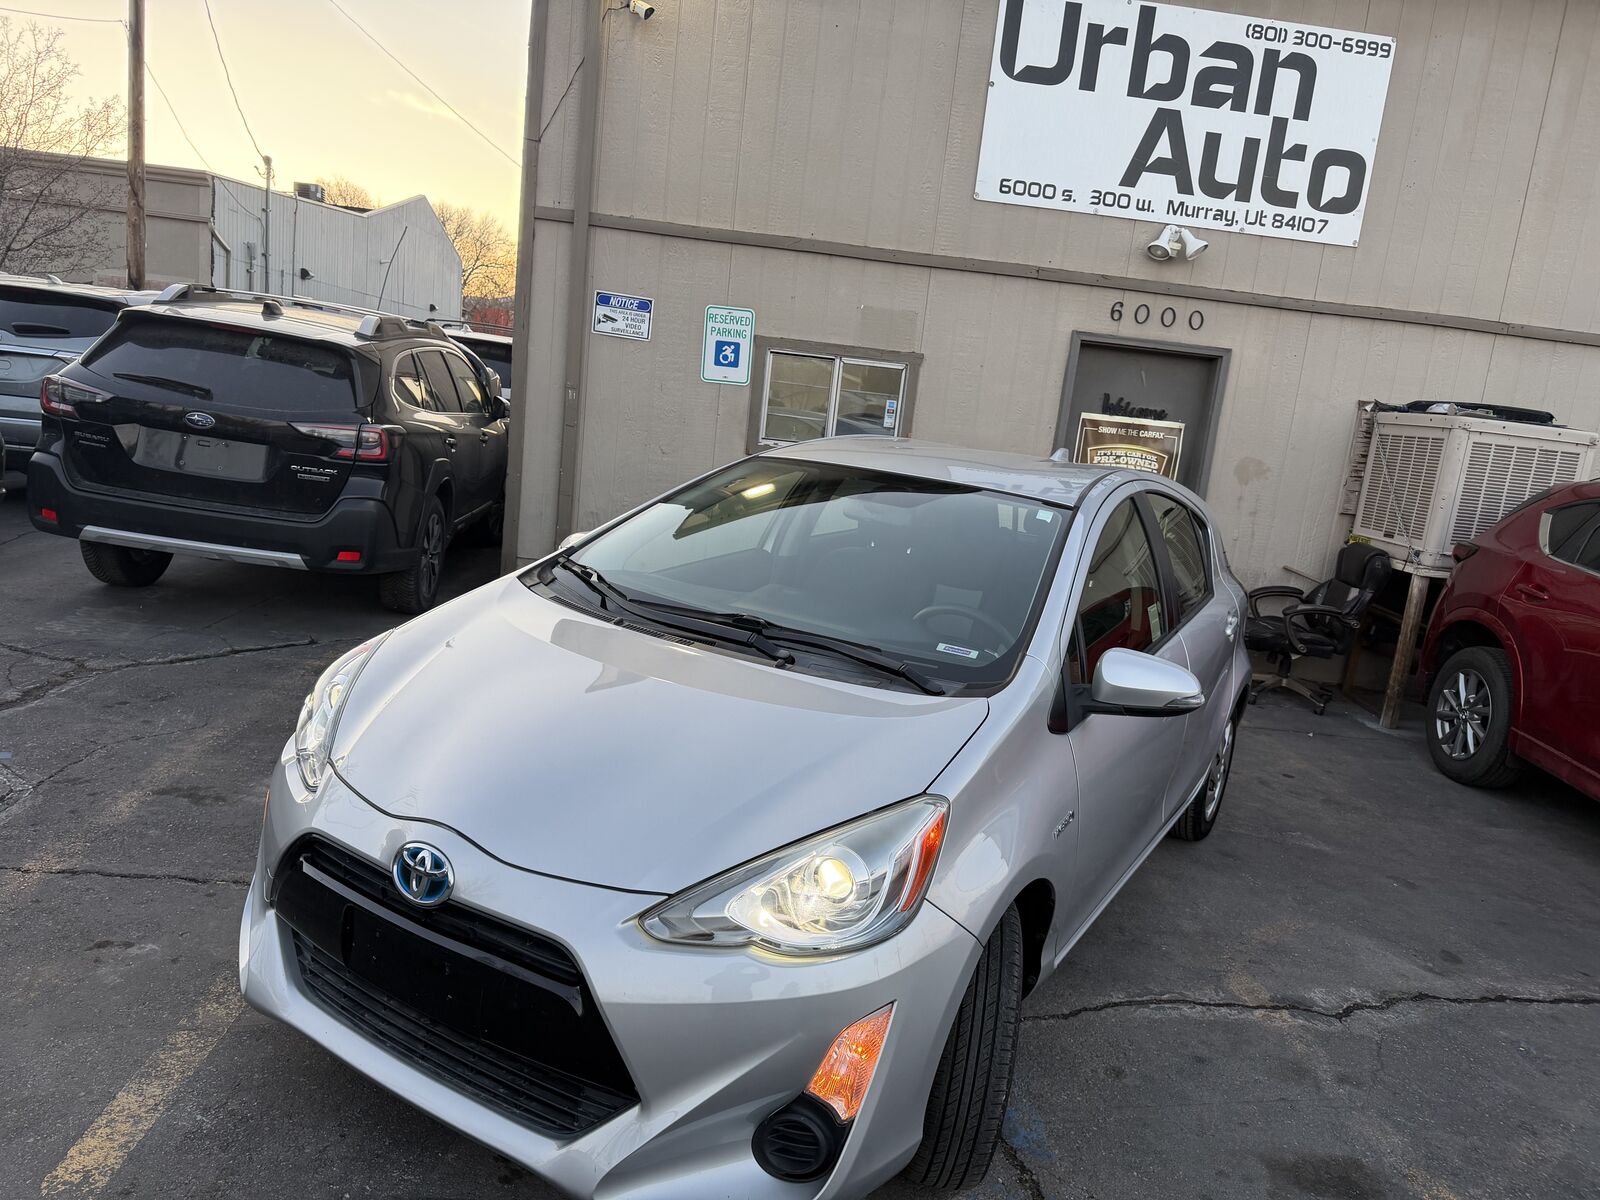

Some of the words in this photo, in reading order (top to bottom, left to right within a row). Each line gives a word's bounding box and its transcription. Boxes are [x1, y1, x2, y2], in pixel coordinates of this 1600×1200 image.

[1245, 23, 1288, 43] (801)
[1292, 30, 1392, 59] 300-6999
[1000, 0, 1318, 122] Urban
[1118, 107, 1367, 215] Auto
[999, 178, 1057, 200] 6000
[1089, 189, 1131, 209] 300
[1166, 200, 1239, 227] Murray,
[1271, 213, 1329, 234] 84107
[610, 296, 640, 310] NOTICE
[630, 317, 646, 325] HOUR
[708, 312, 751, 327] RESERVED
[1110, 301, 1204, 330] 6000
[611, 327, 644, 337] SURVEILLANCE
[625, 322, 642, 331] VIDEO
[710, 327, 747, 340] PARKING
[1098, 426, 1117, 434] SHOW
[1127, 429, 1139, 437] THE
[1139, 430, 1165, 439] CARFAX
[1093, 456, 1159, 470] PRE-OWNED
